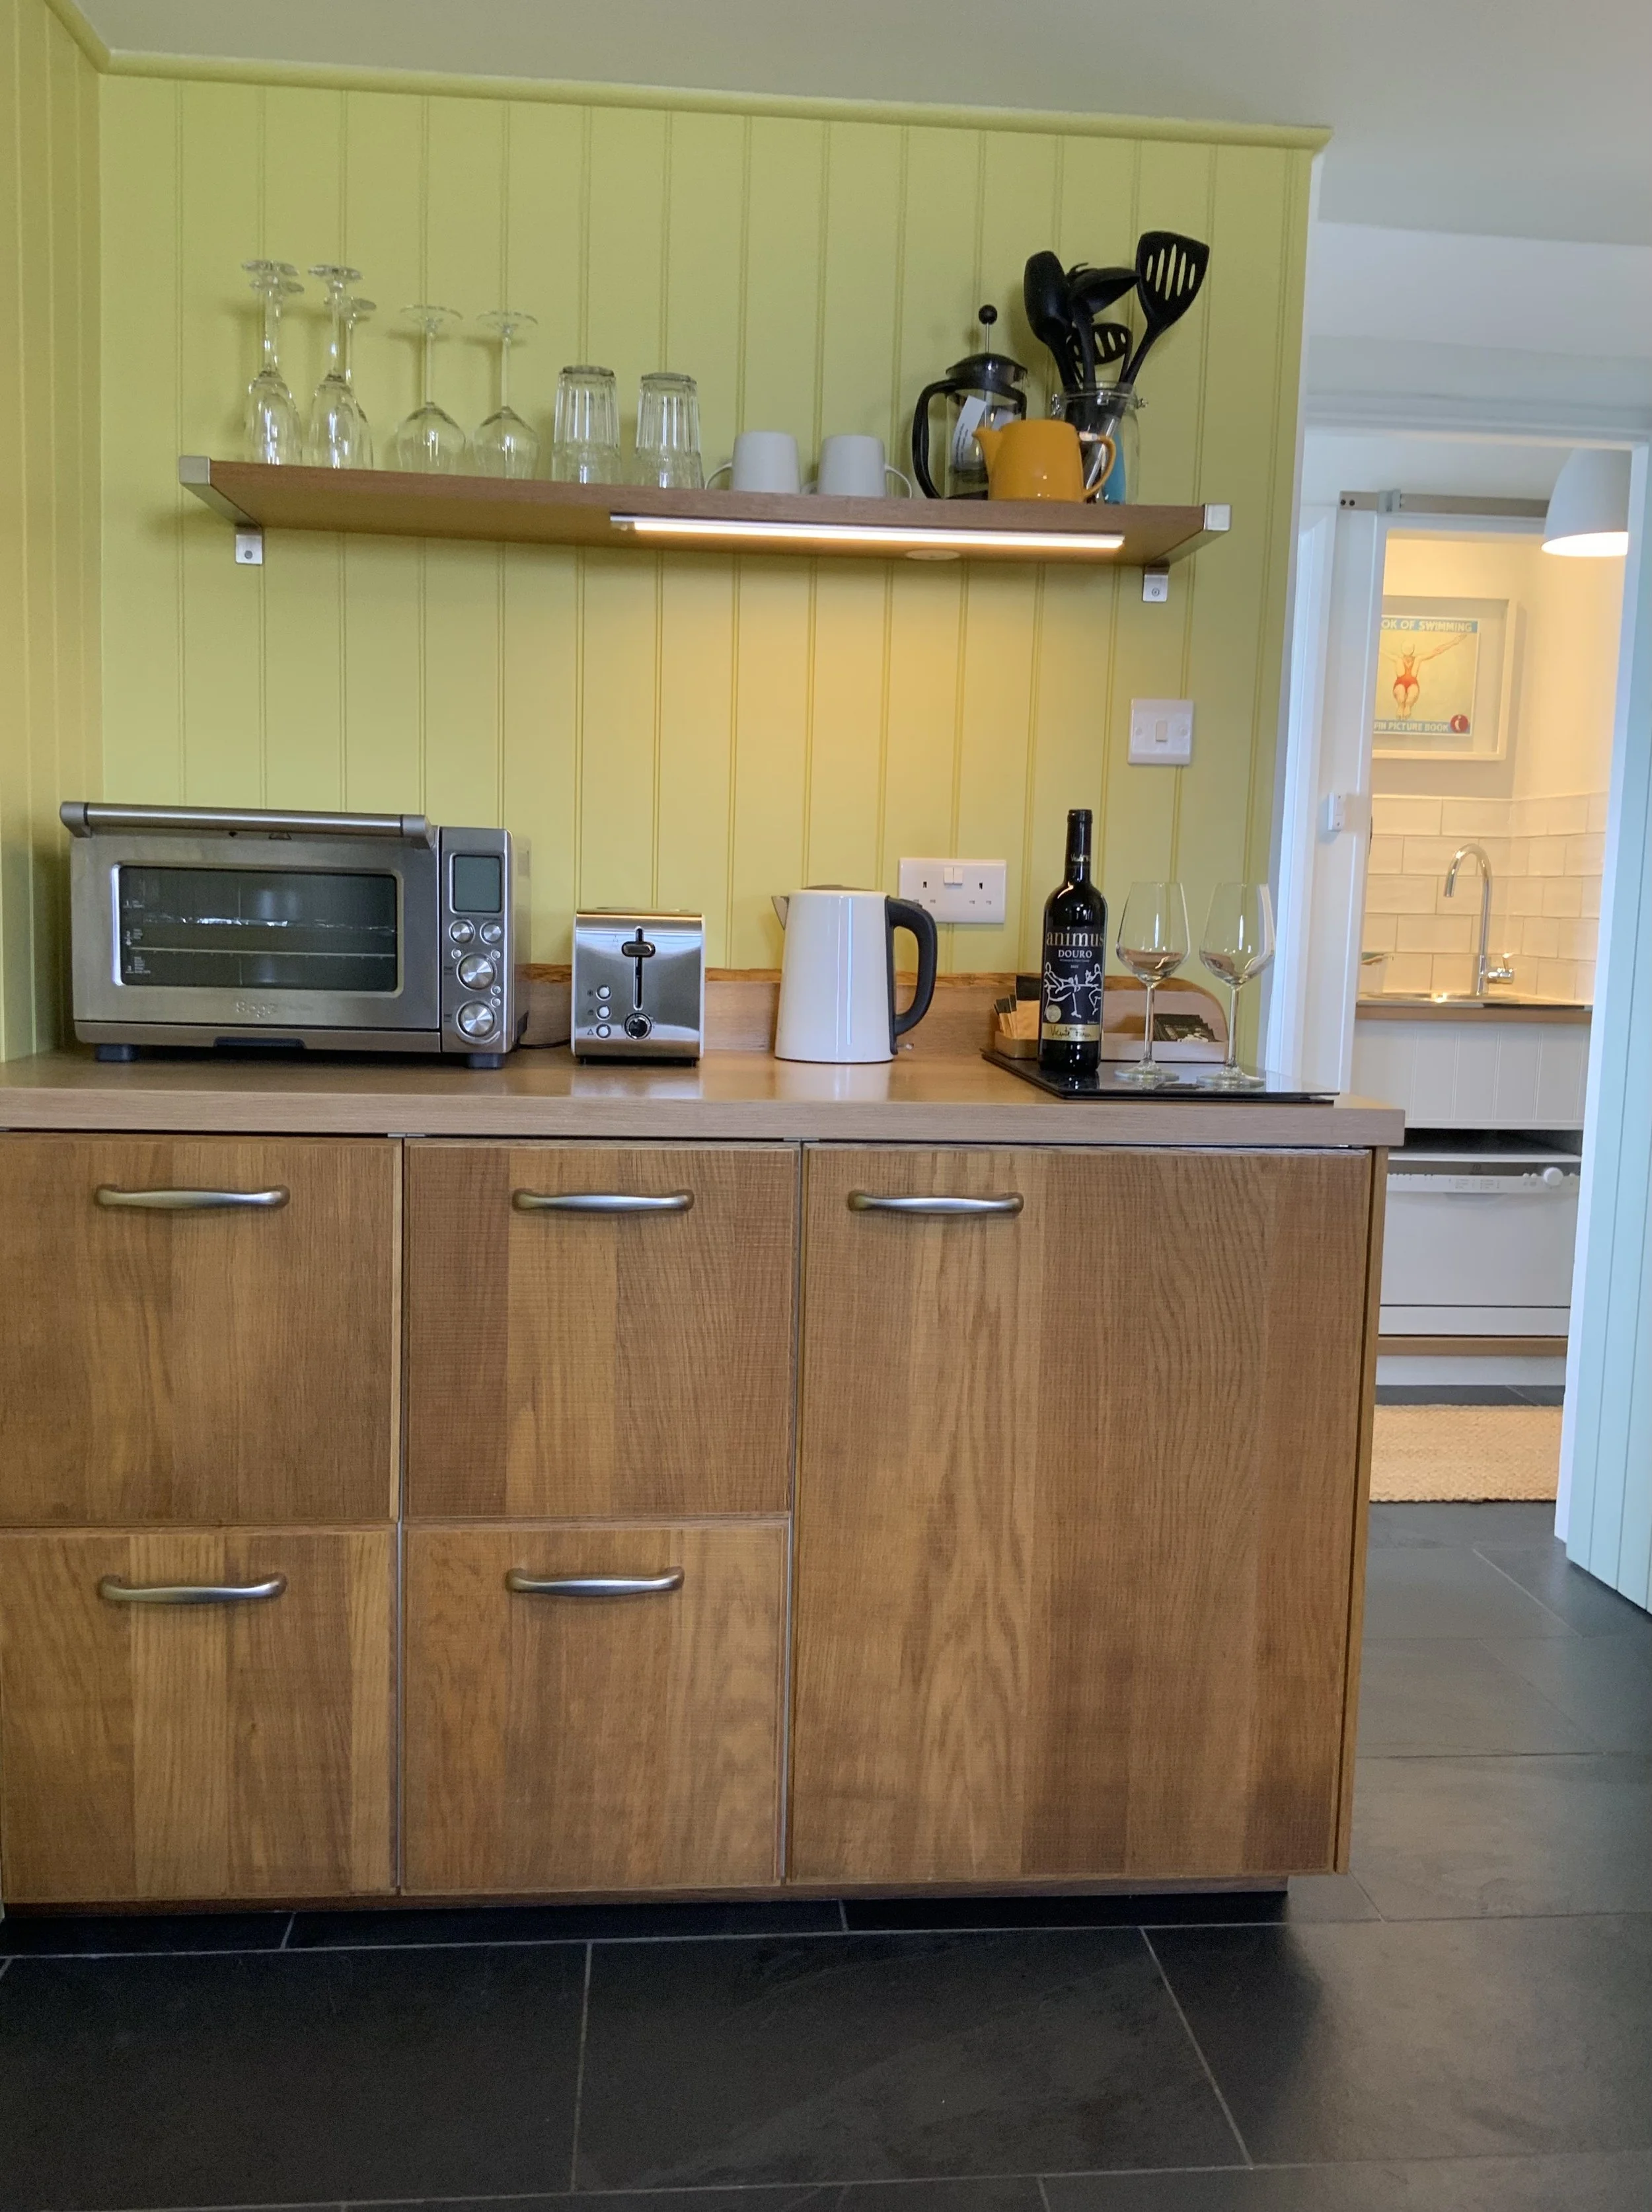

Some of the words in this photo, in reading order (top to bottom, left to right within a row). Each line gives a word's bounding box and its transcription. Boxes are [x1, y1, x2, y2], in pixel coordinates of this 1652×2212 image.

[1400, 619, 1415, 630] OF
[1418, 621, 1472, 632] SWIMMING
[1388, 722, 1422, 731] PICTURE
[1424, 723, 1448, 732] BOOK
[1047, 927, 1104, 946] animus
[1058, 950, 1092, 958] DOURO
